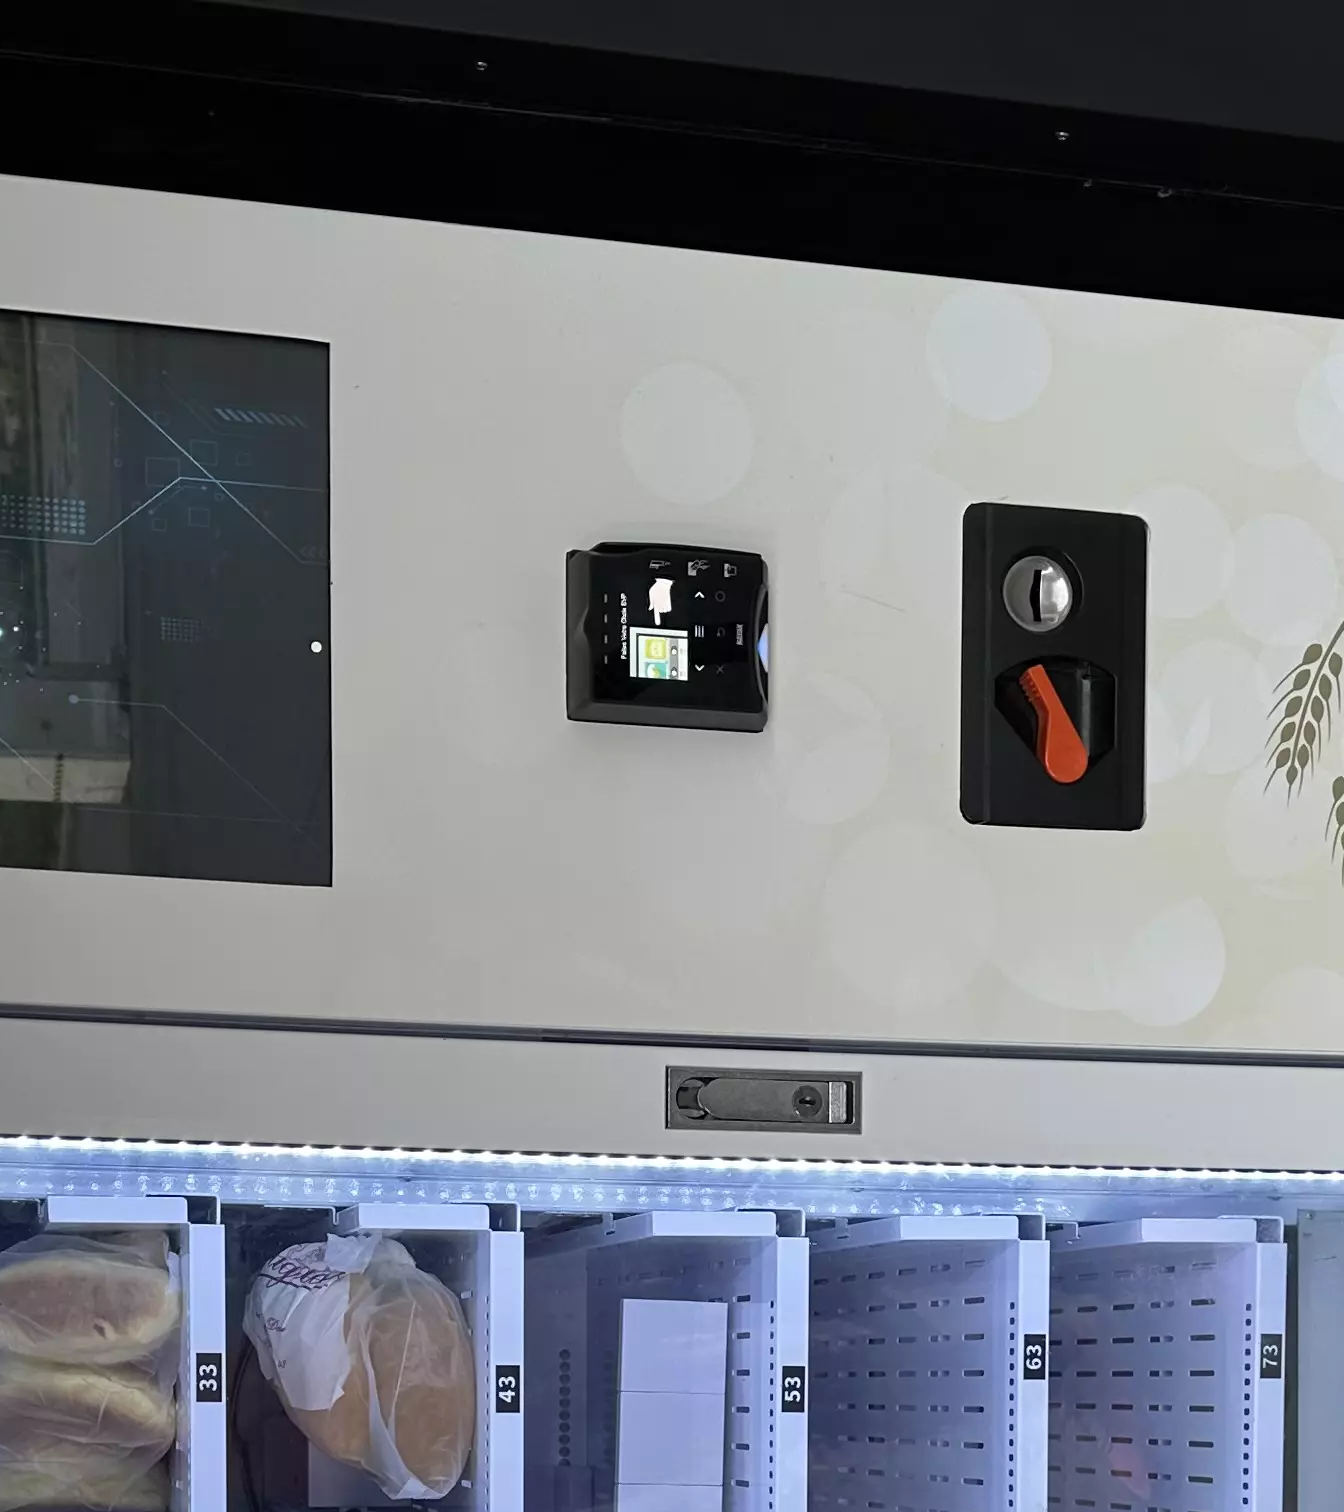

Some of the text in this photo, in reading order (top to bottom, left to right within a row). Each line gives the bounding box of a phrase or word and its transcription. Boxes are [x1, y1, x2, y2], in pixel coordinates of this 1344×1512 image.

[1026, 1345, 1041, 1369] 63
[1263, 1345, 1277, 1368] 73
[199, 1365, 217, 1391] 33
[499, 1377, 515, 1402] 43
[785, 1377, 800, 1402] 53
